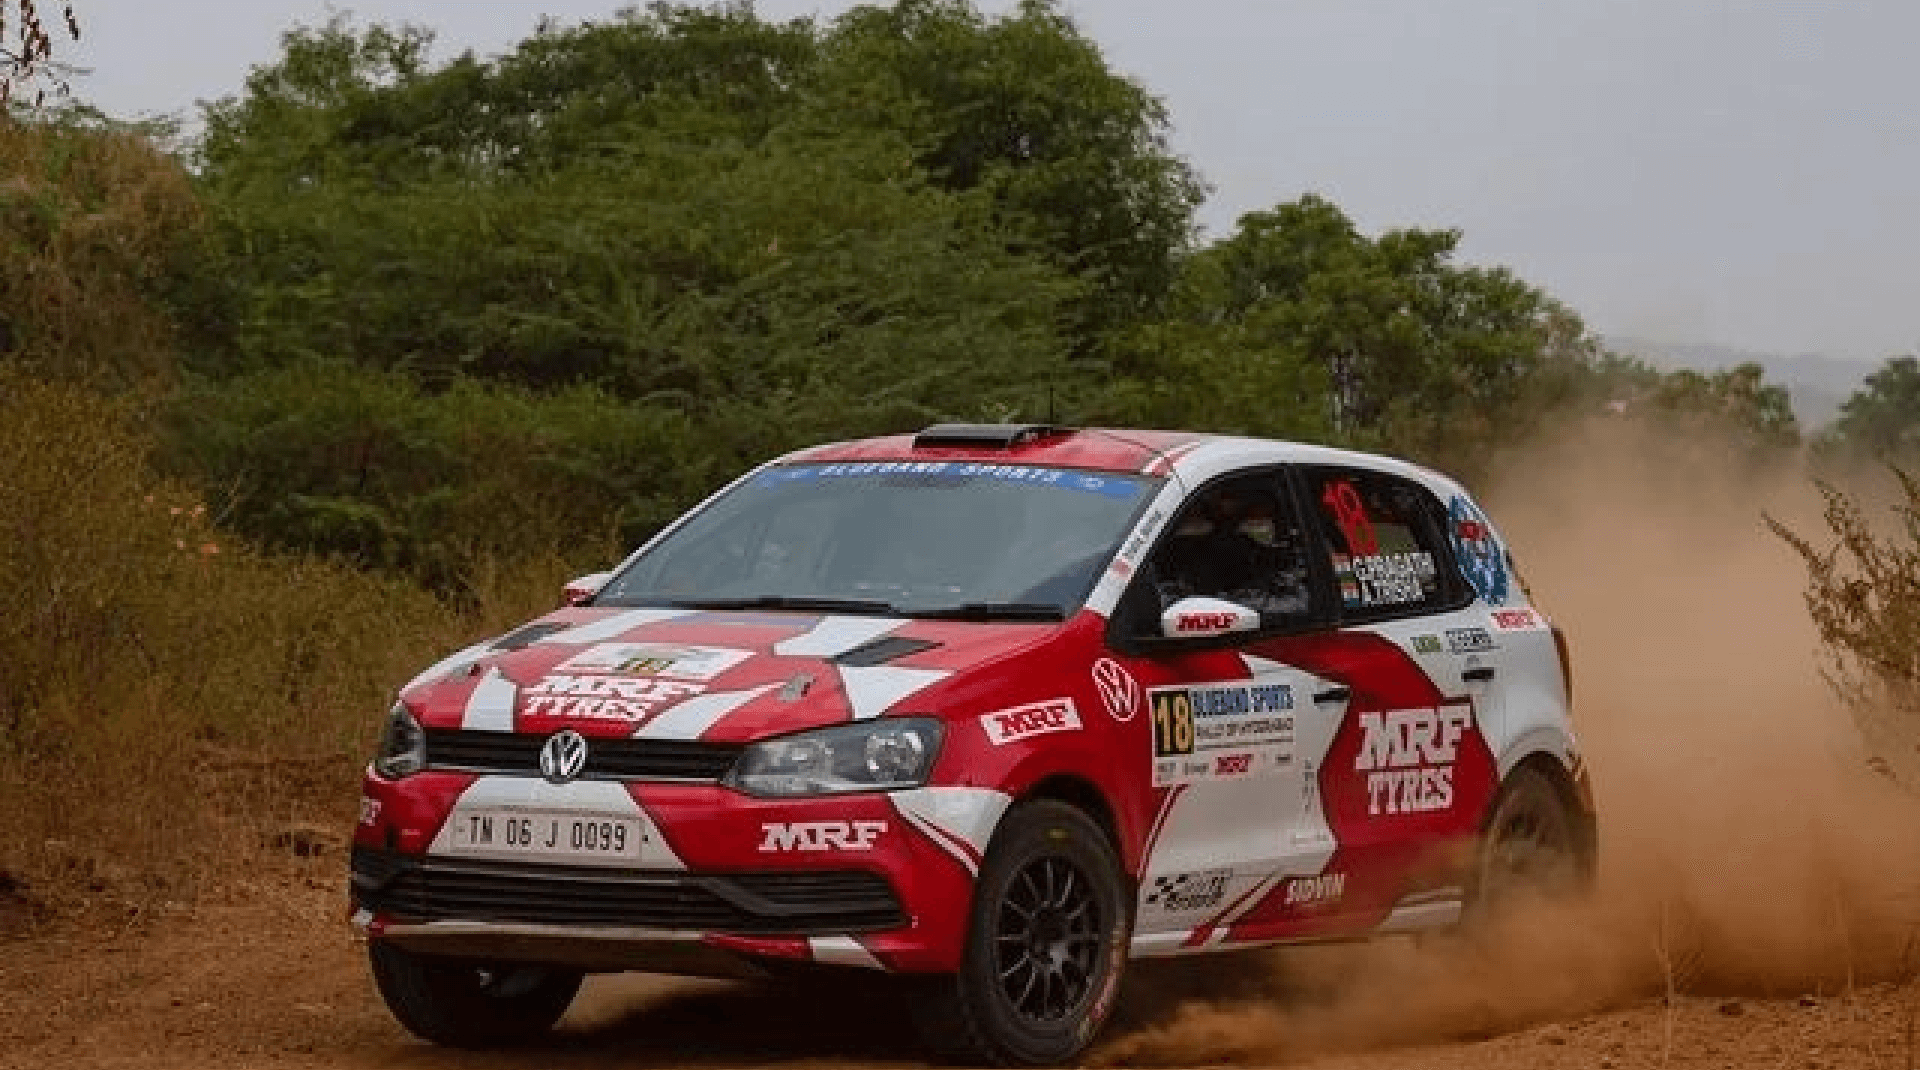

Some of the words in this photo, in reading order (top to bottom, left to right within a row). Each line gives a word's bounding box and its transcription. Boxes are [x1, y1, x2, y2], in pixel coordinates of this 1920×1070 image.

[1322, 477, 1379, 554] 18
[1175, 612, 1238, 632] MRF
[522, 696, 652, 722] TYRES
[1251, 685, 1294, 713] SPORTS
[993, 702, 1069, 737] MRF
[1157, 693, 1192, 753] 18
[1355, 705, 1472, 770] MRF
[1367, 766, 1454, 815] TYRES
[470, 815, 494, 845] TN
[506, 818, 532, 846] 06
[545, 820, 559, 848] J
[572, 822, 626, 852] 0099
[759, 820, 889, 853] MRF
